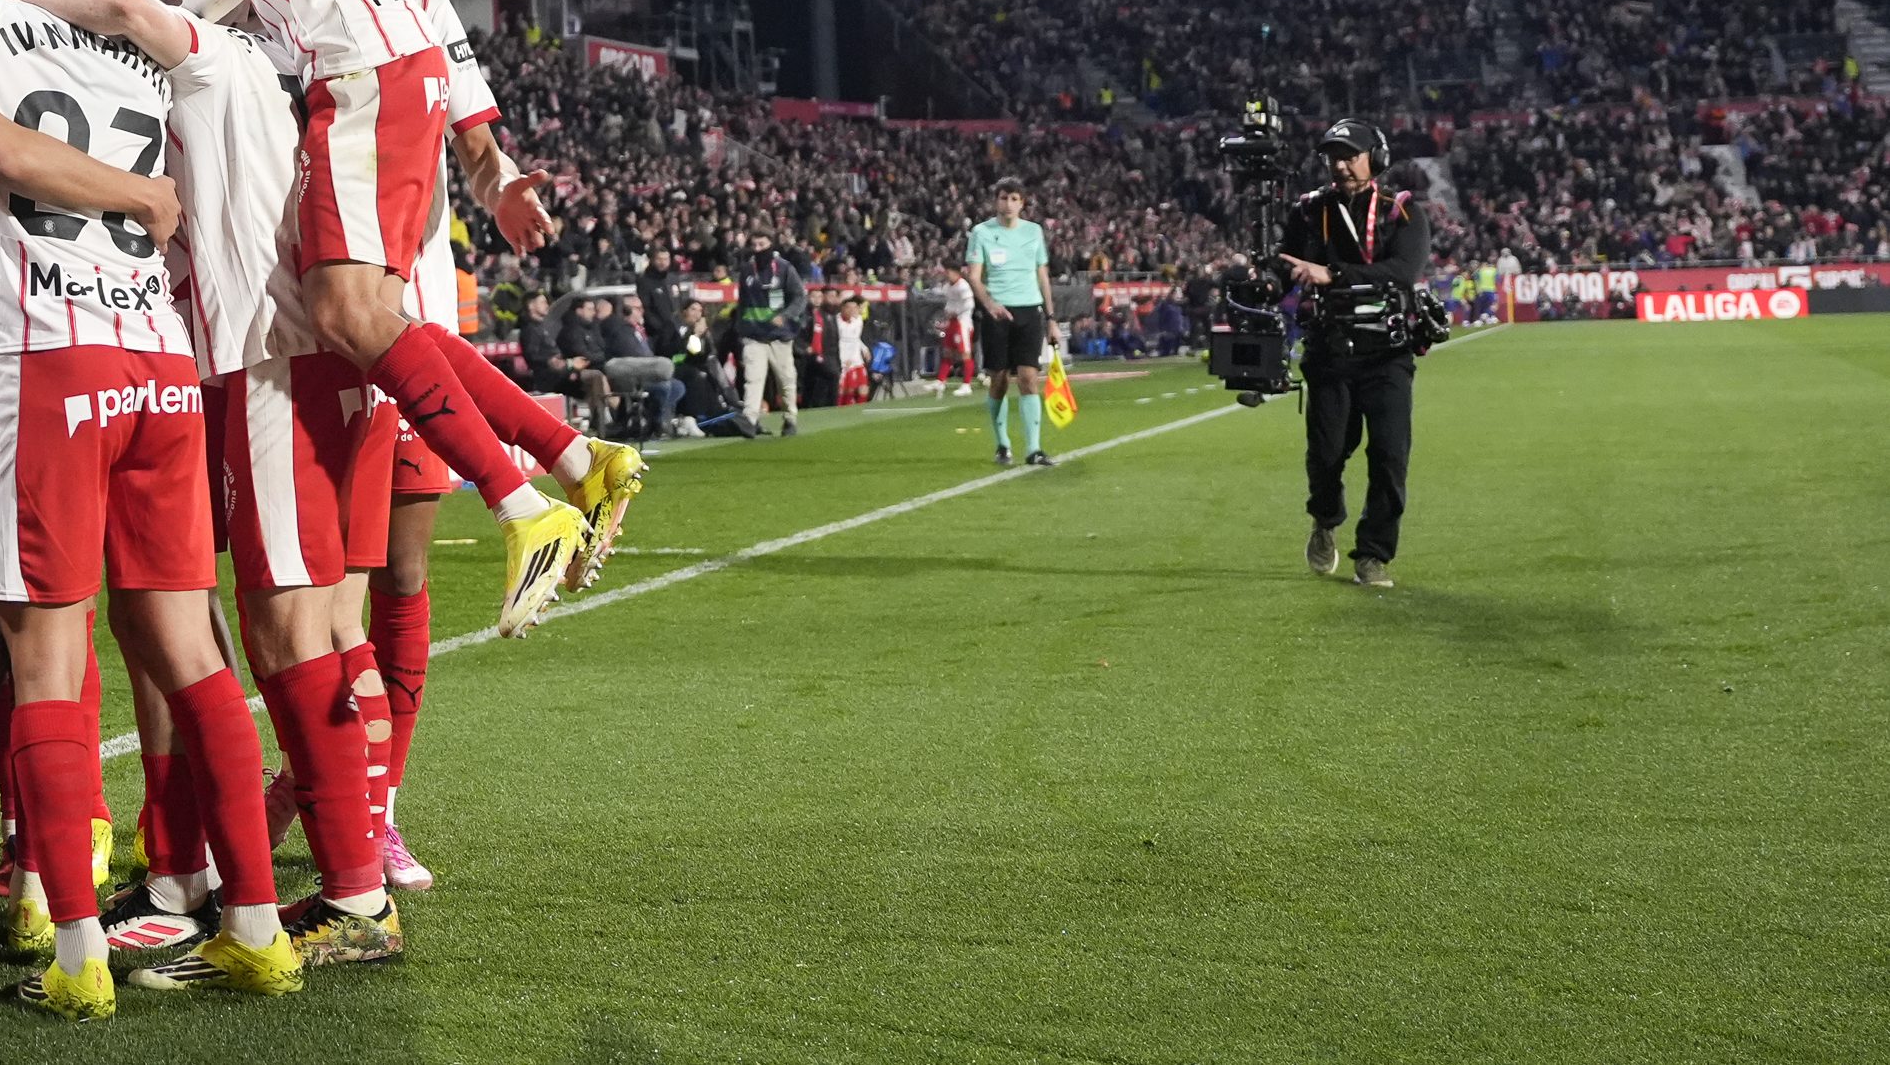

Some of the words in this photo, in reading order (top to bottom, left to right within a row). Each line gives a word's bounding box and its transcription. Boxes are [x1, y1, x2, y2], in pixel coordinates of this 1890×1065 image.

[453, 44, 475, 61] HYL
[1643, 292, 1761, 323] LALIGA
[96, 379, 203, 428] parlem
